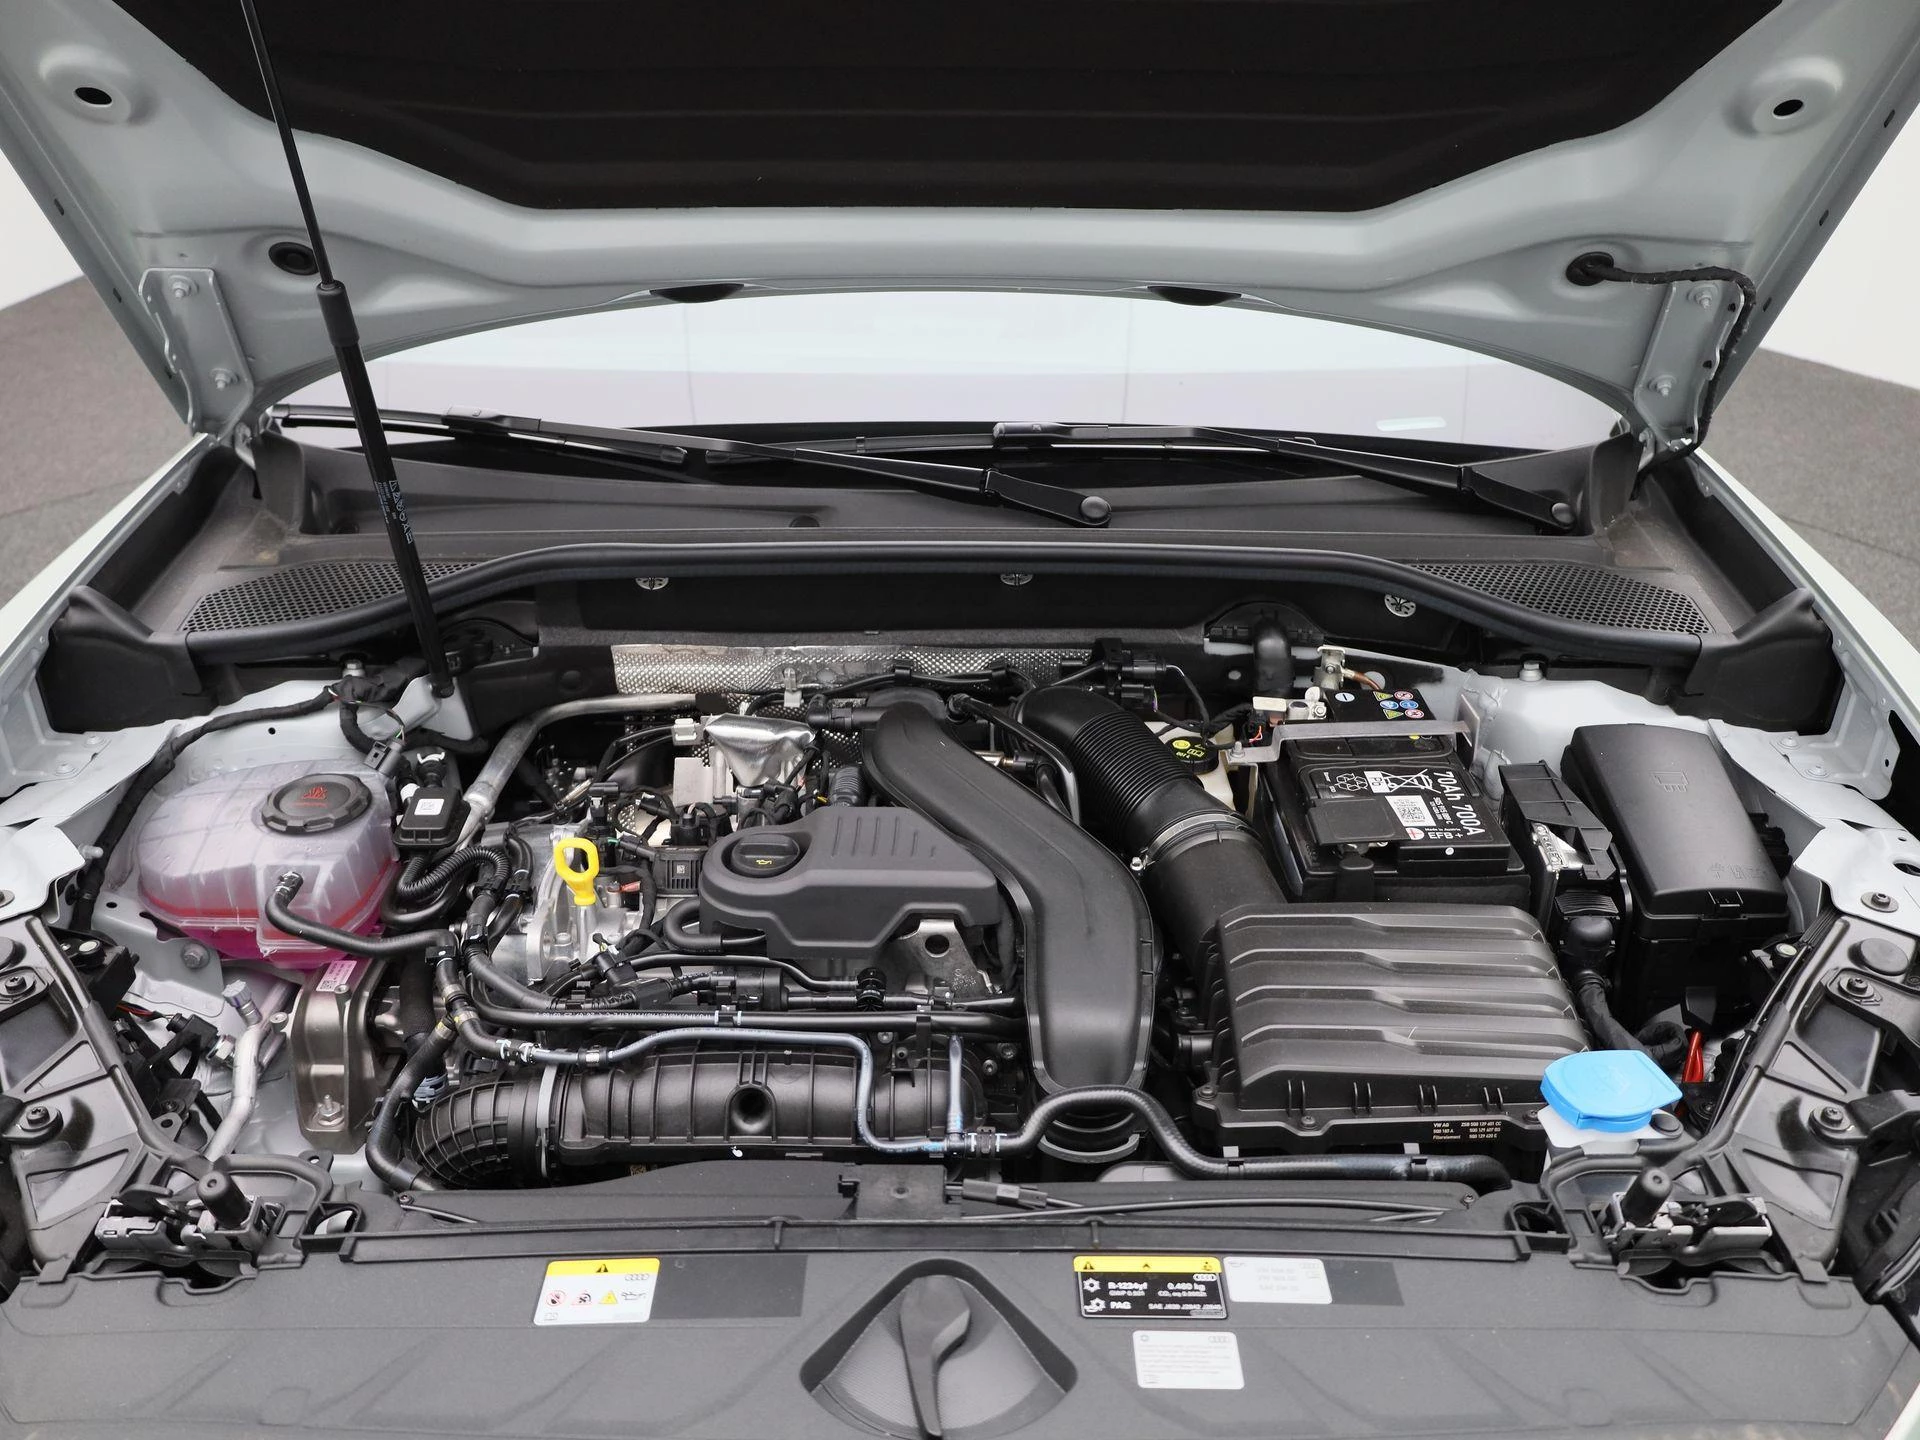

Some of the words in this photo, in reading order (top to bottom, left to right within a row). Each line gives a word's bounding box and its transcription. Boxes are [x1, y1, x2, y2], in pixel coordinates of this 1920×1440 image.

[1372, 776, 1382, 787] Pb
[1433, 771, 1465, 801] 70Ah
[1452, 804, 1486, 836] 700A
[1193, 1282, 1206, 1291] kg
[1110, 1302, 1131, 1310] PAG
